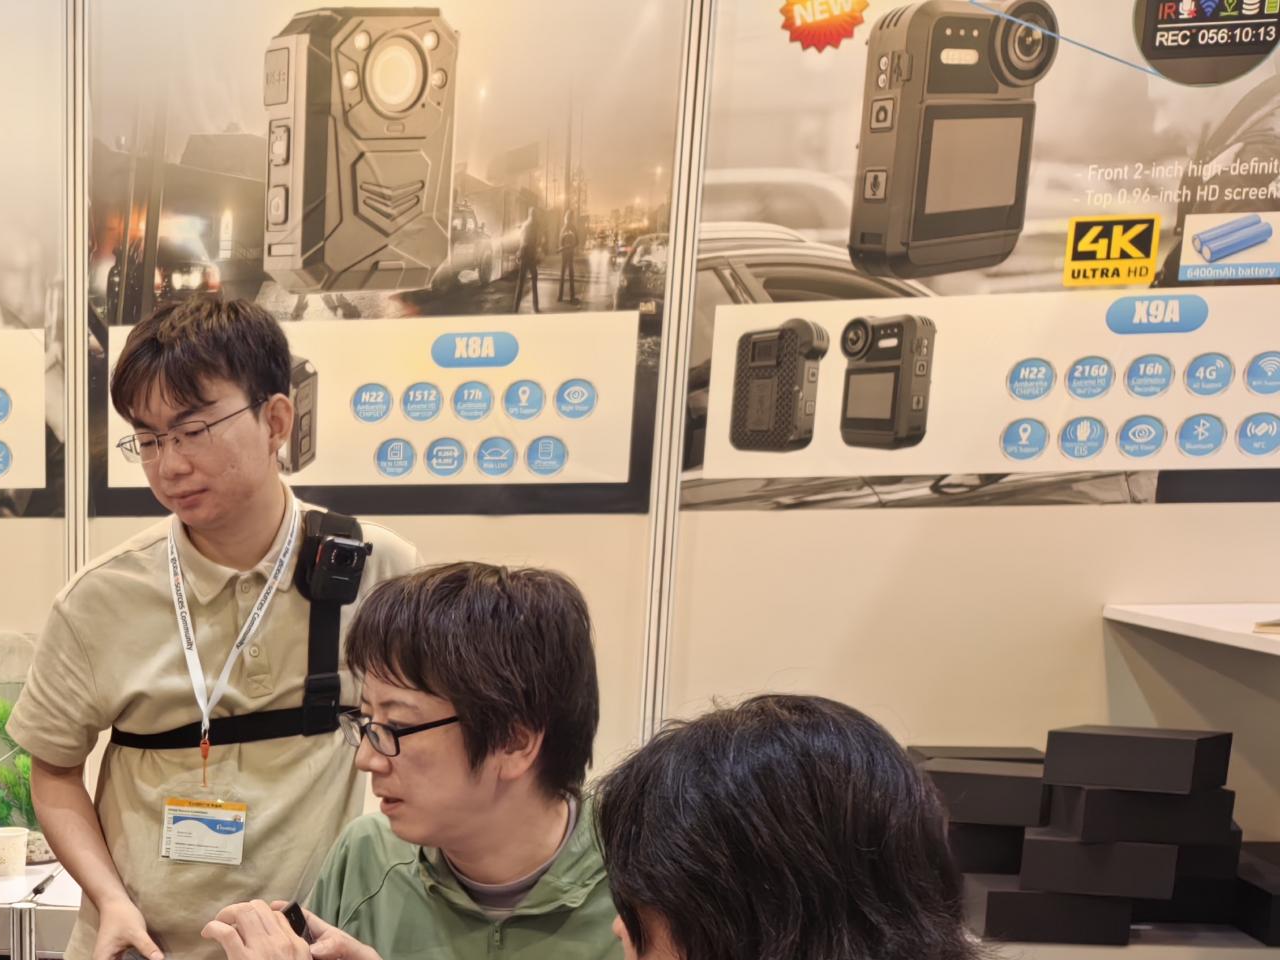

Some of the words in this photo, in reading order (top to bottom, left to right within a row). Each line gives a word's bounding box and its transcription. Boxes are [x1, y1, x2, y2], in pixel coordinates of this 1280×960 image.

[1155, 31, 1190, 47] REC
[1198, 26, 1276, 44] 056:10:13
[1087, 164, 1129, 181] Front
[1133, 161, 1184, 178] 2-inch
[1188, 156, 1280, 182] high-definit
[1086, 190, 1113, 208] Top
[1117, 186, 1191, 205] 0.96-inch
[1196, 184, 1219, 202] HD
[1077, 223, 1150, 260] 4K
[1071, 267, 1121, 280] ULTRA
[1127, 266, 1149, 278] HD
[1238, 265, 1276, 279] battery
[1132, 299, 1180, 324] X9A
[454, 336, 496, 359] X8A
[1138, 363, 1163, 376] 16h
[1194, 366, 1217, 380] 4G
[181, 611, 194, 651] Community
[235, 612, 260, 650] Community
